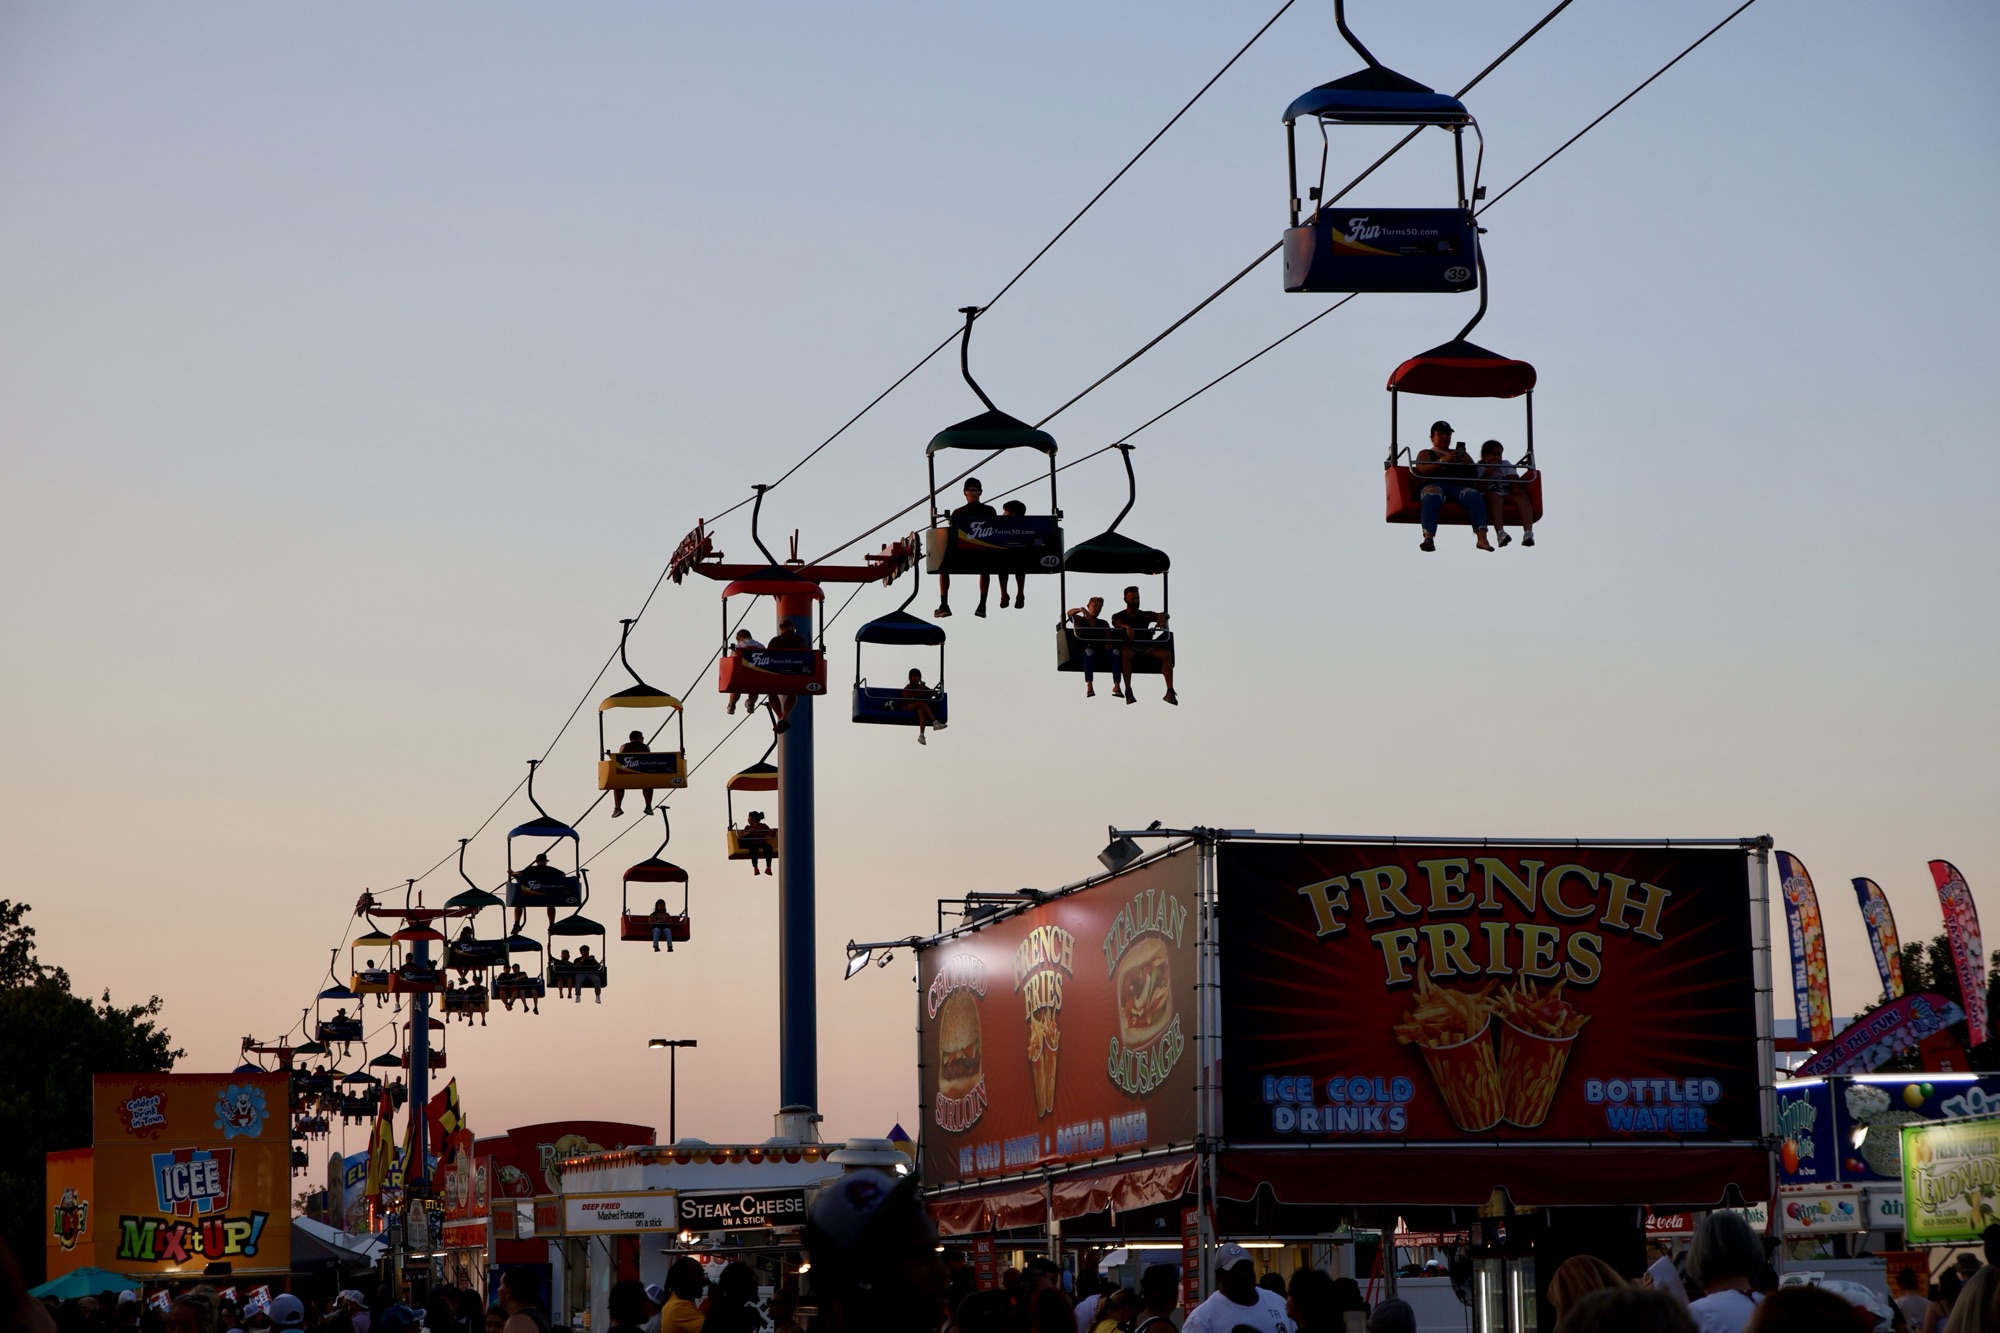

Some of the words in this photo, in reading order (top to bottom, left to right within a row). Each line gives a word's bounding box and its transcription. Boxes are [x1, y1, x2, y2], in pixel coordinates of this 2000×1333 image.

[1447, 268, 1467, 281] 39
[1043, 557, 1057, 566] 40
[1297, 856, 1673, 941] FRENCH
[1103, 888, 1188, 976] ITALIAN
[1789, 909, 1804, 958] TASTE
[1012, 925, 1075, 992] FRENCH
[1371, 921, 1604, 986] FRIES
[1873, 930, 1888, 977] TASTE
[1948, 913, 1964, 960] TASTE
[1959, 962, 1974, 991] THE
[927, 953, 988, 1019] CHOPPED
[1795, 960, 1806, 991] THE
[1023, 968, 1063, 1020] FRIES
[1107, 1013, 1184, 1095] SAUSAGE
[1806, 1046, 1845, 1076] TASTE
[1845, 1031, 1869, 1051] THE
[1870, 1009, 1900, 1035] FUN!
[127, 1096, 160, 1110] Coldest
[935, 1074, 988, 1133] SIRLOIN
[1262, 1074, 1315, 1104] ICE
[1326, 1074, 1416, 1104] COLD
[1584, 1077, 1723, 1105] BOTTLED
[132, 1119, 141, 1127] in
[133, 1105, 156, 1119] Drink
[1273, 1104, 1408, 1133] DRINKS
[1607, 1105, 1709, 1133] WATER
[959, 1146, 974, 1174] ICE
[976, 1141, 1001, 1171] COLD
[1003, 1133, 1041, 1167] DRINKS
[1056, 1119, 1106, 1157] BOTTLED
[1108, 1109, 1149, 1149] WATER
[162, 1159, 222, 1204] ICEE
[598, 1211, 619, 1221] Mashed
[620, 1210, 645, 1220] Potatoes
[601, 1202, 621, 1210] FRIED
[681, 1198, 731, 1220] STEAK
[740, 1195, 804, 1215] CHEESE
[722, 1218, 733, 1226] ON
[735, 1217, 741, 1225] A
[742, 1215, 766, 1225] STICK
[649, 1218, 662, 1227] stick
